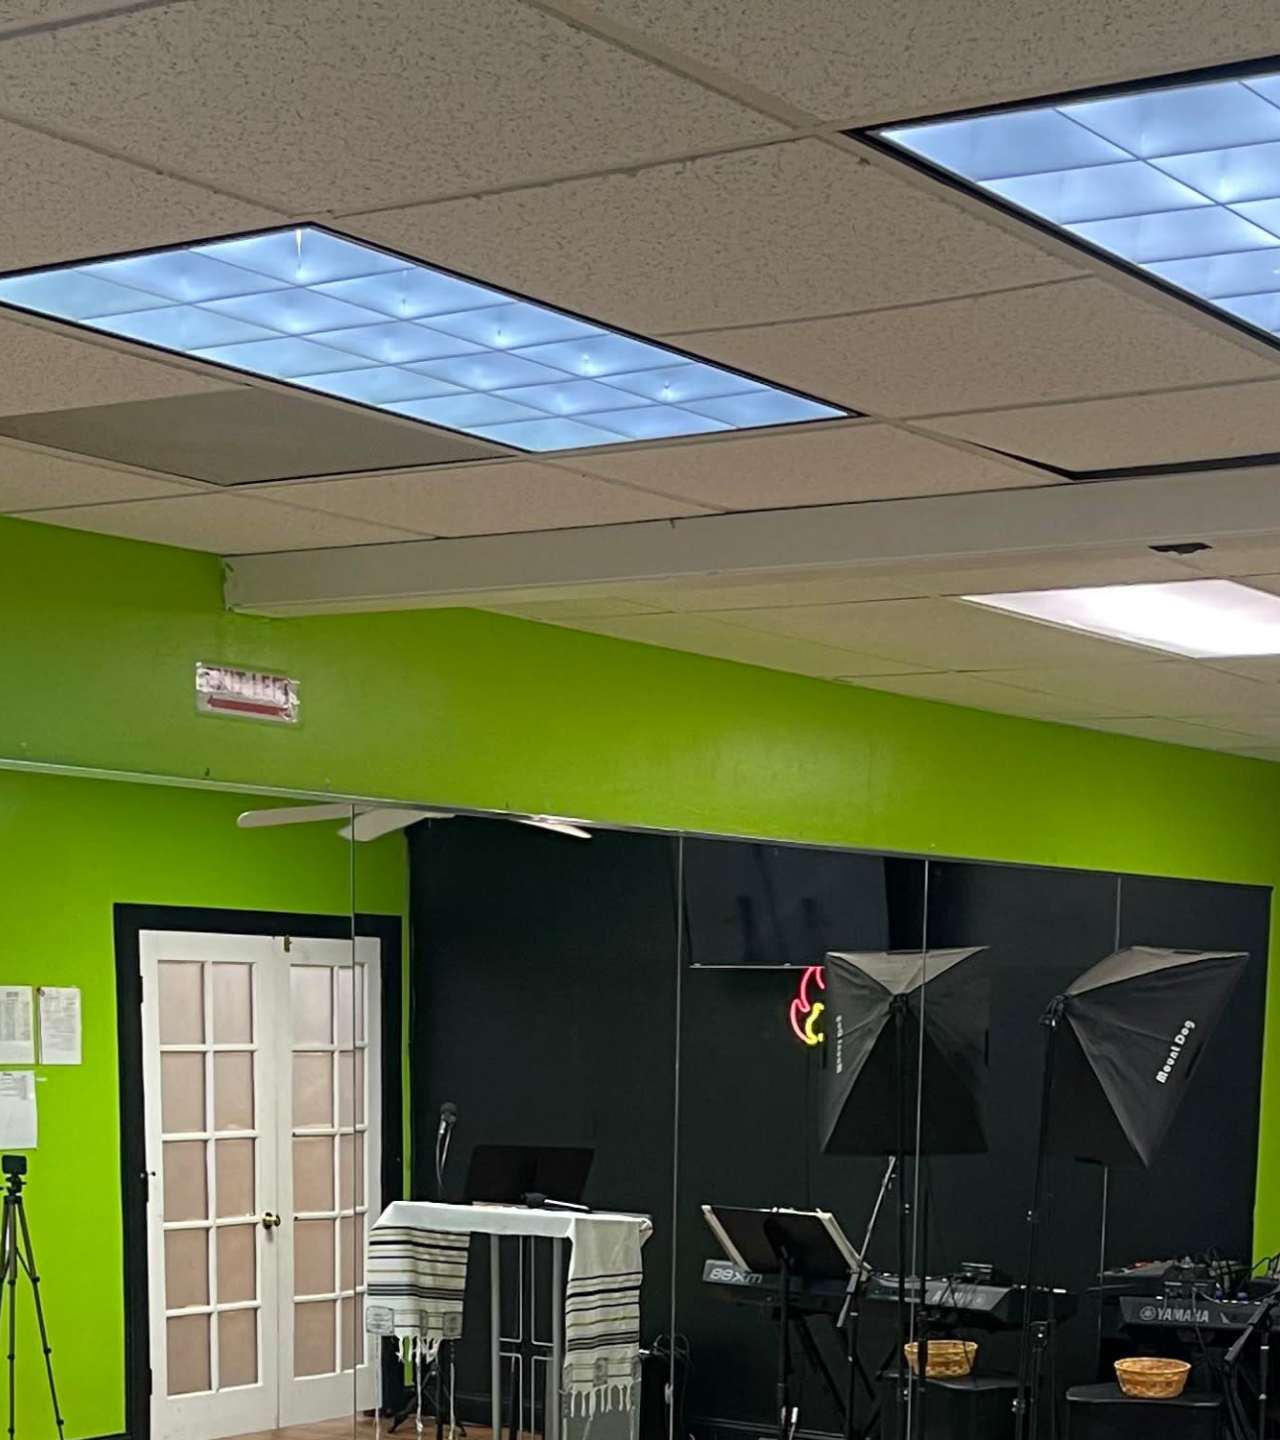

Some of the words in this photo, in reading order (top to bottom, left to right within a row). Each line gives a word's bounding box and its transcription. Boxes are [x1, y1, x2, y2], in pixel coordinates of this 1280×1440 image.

[1154, 1045, 1182, 1084] Mount
[1174, 1020, 1196, 1046] Dog
[1157, 1307, 1209, 1323] YAMAHA
